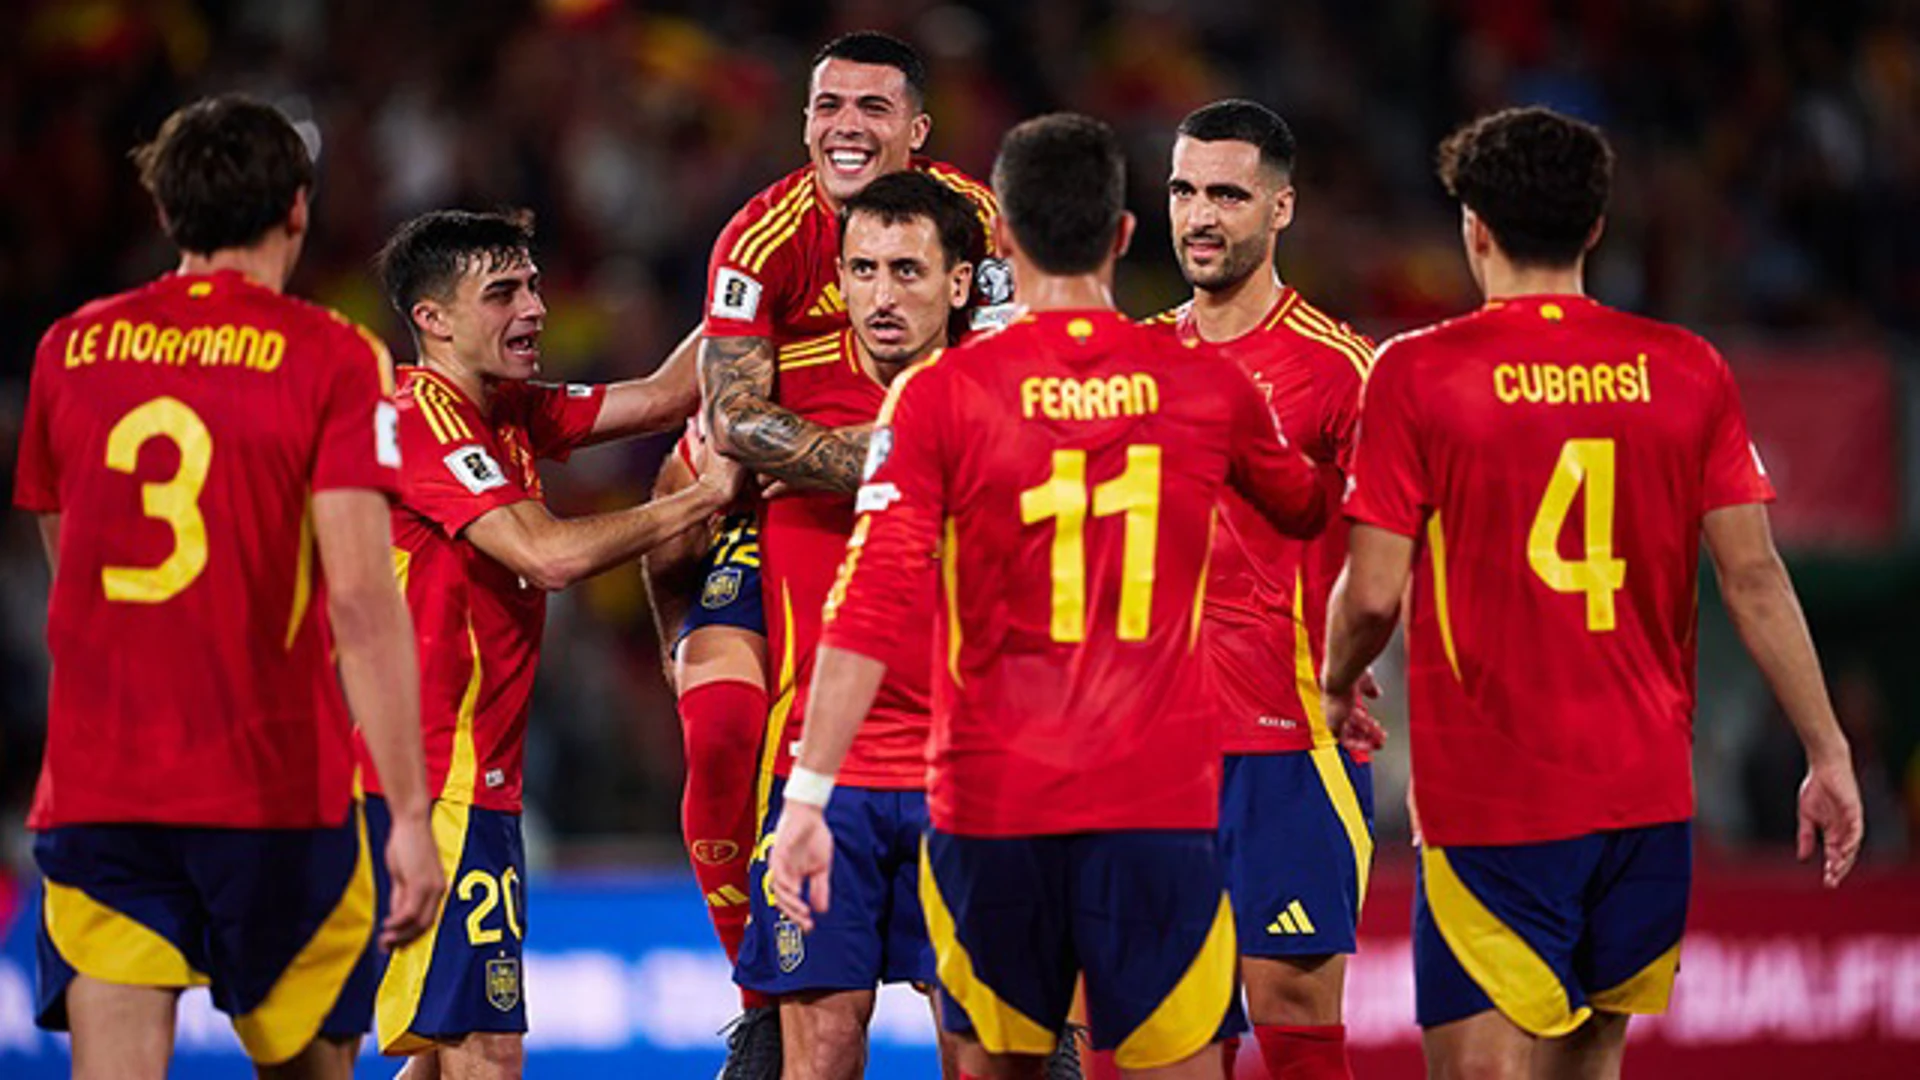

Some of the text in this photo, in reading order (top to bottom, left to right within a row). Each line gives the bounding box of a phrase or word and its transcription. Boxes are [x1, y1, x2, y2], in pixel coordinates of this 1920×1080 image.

[65, 320, 287, 373] LE NORMAND
[1021, 373, 1159, 420] FERRAN
[1493, 352, 1651, 404] CUBARSÍ
[101, 395, 213, 604] 3
[1019, 443, 1162, 643] 11
[1526, 437, 1627, 632] 4
